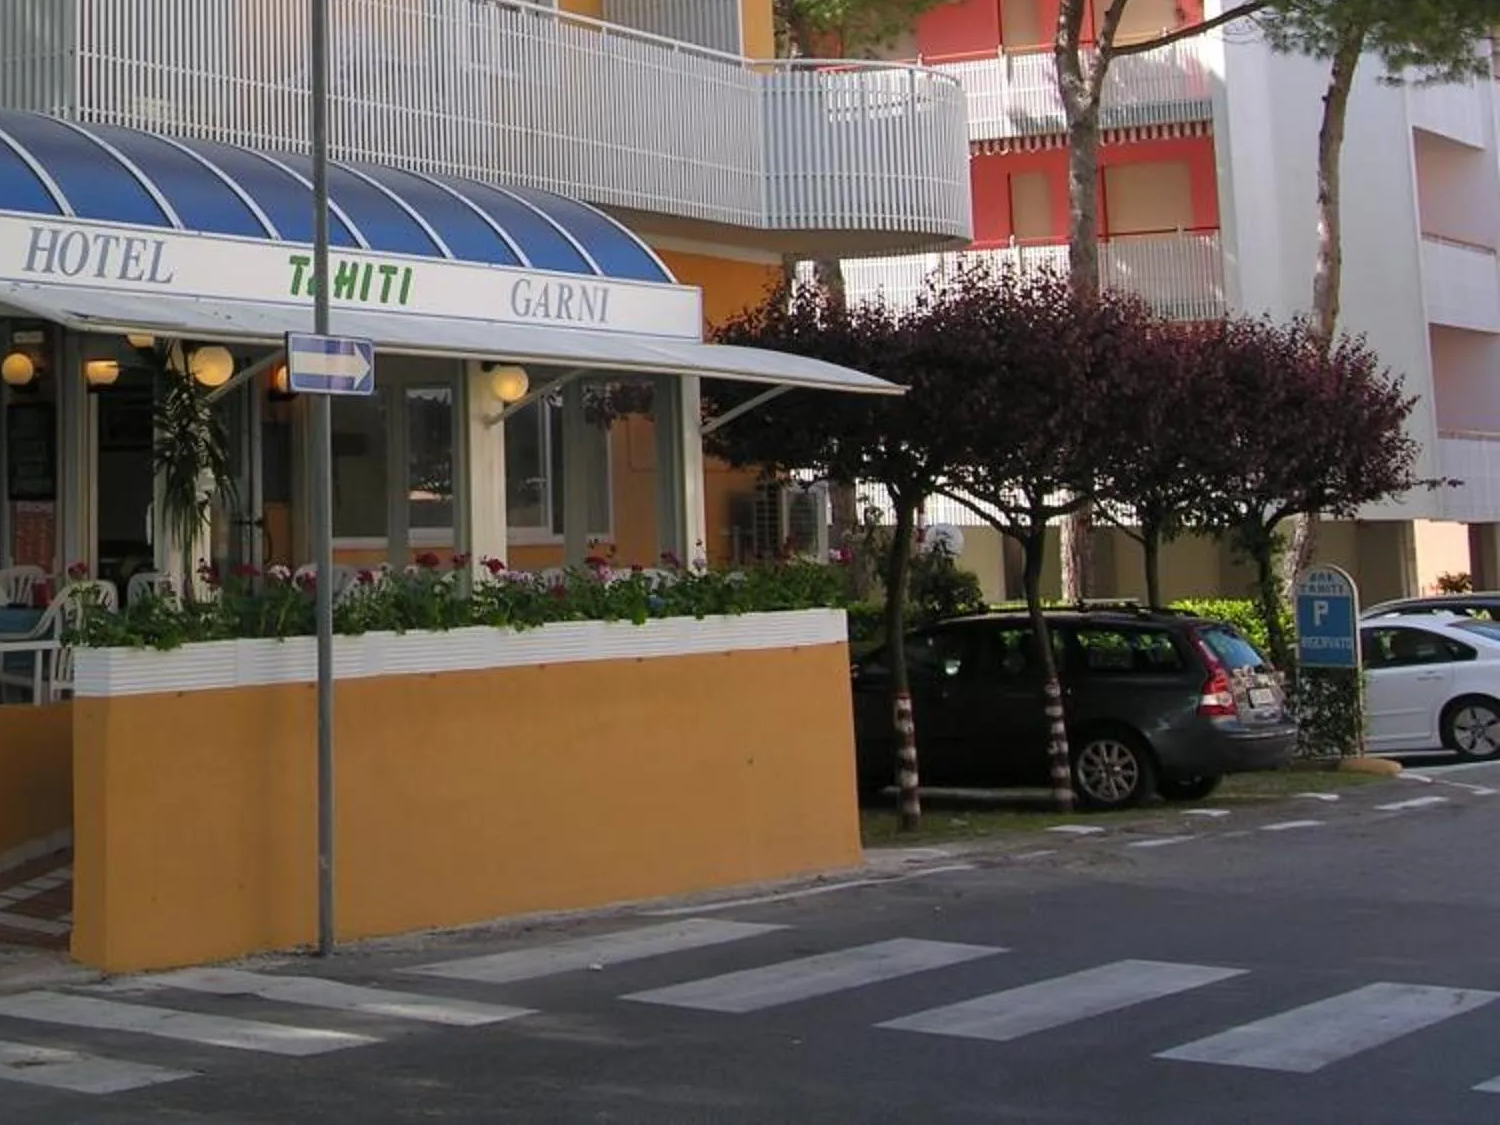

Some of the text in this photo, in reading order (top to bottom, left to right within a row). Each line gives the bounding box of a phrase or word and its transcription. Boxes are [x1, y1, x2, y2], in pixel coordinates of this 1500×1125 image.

[22, 226, 175, 284] HOTEL
[510, 277, 611, 324] GARNI
[1313, 600, 1329, 626] P
